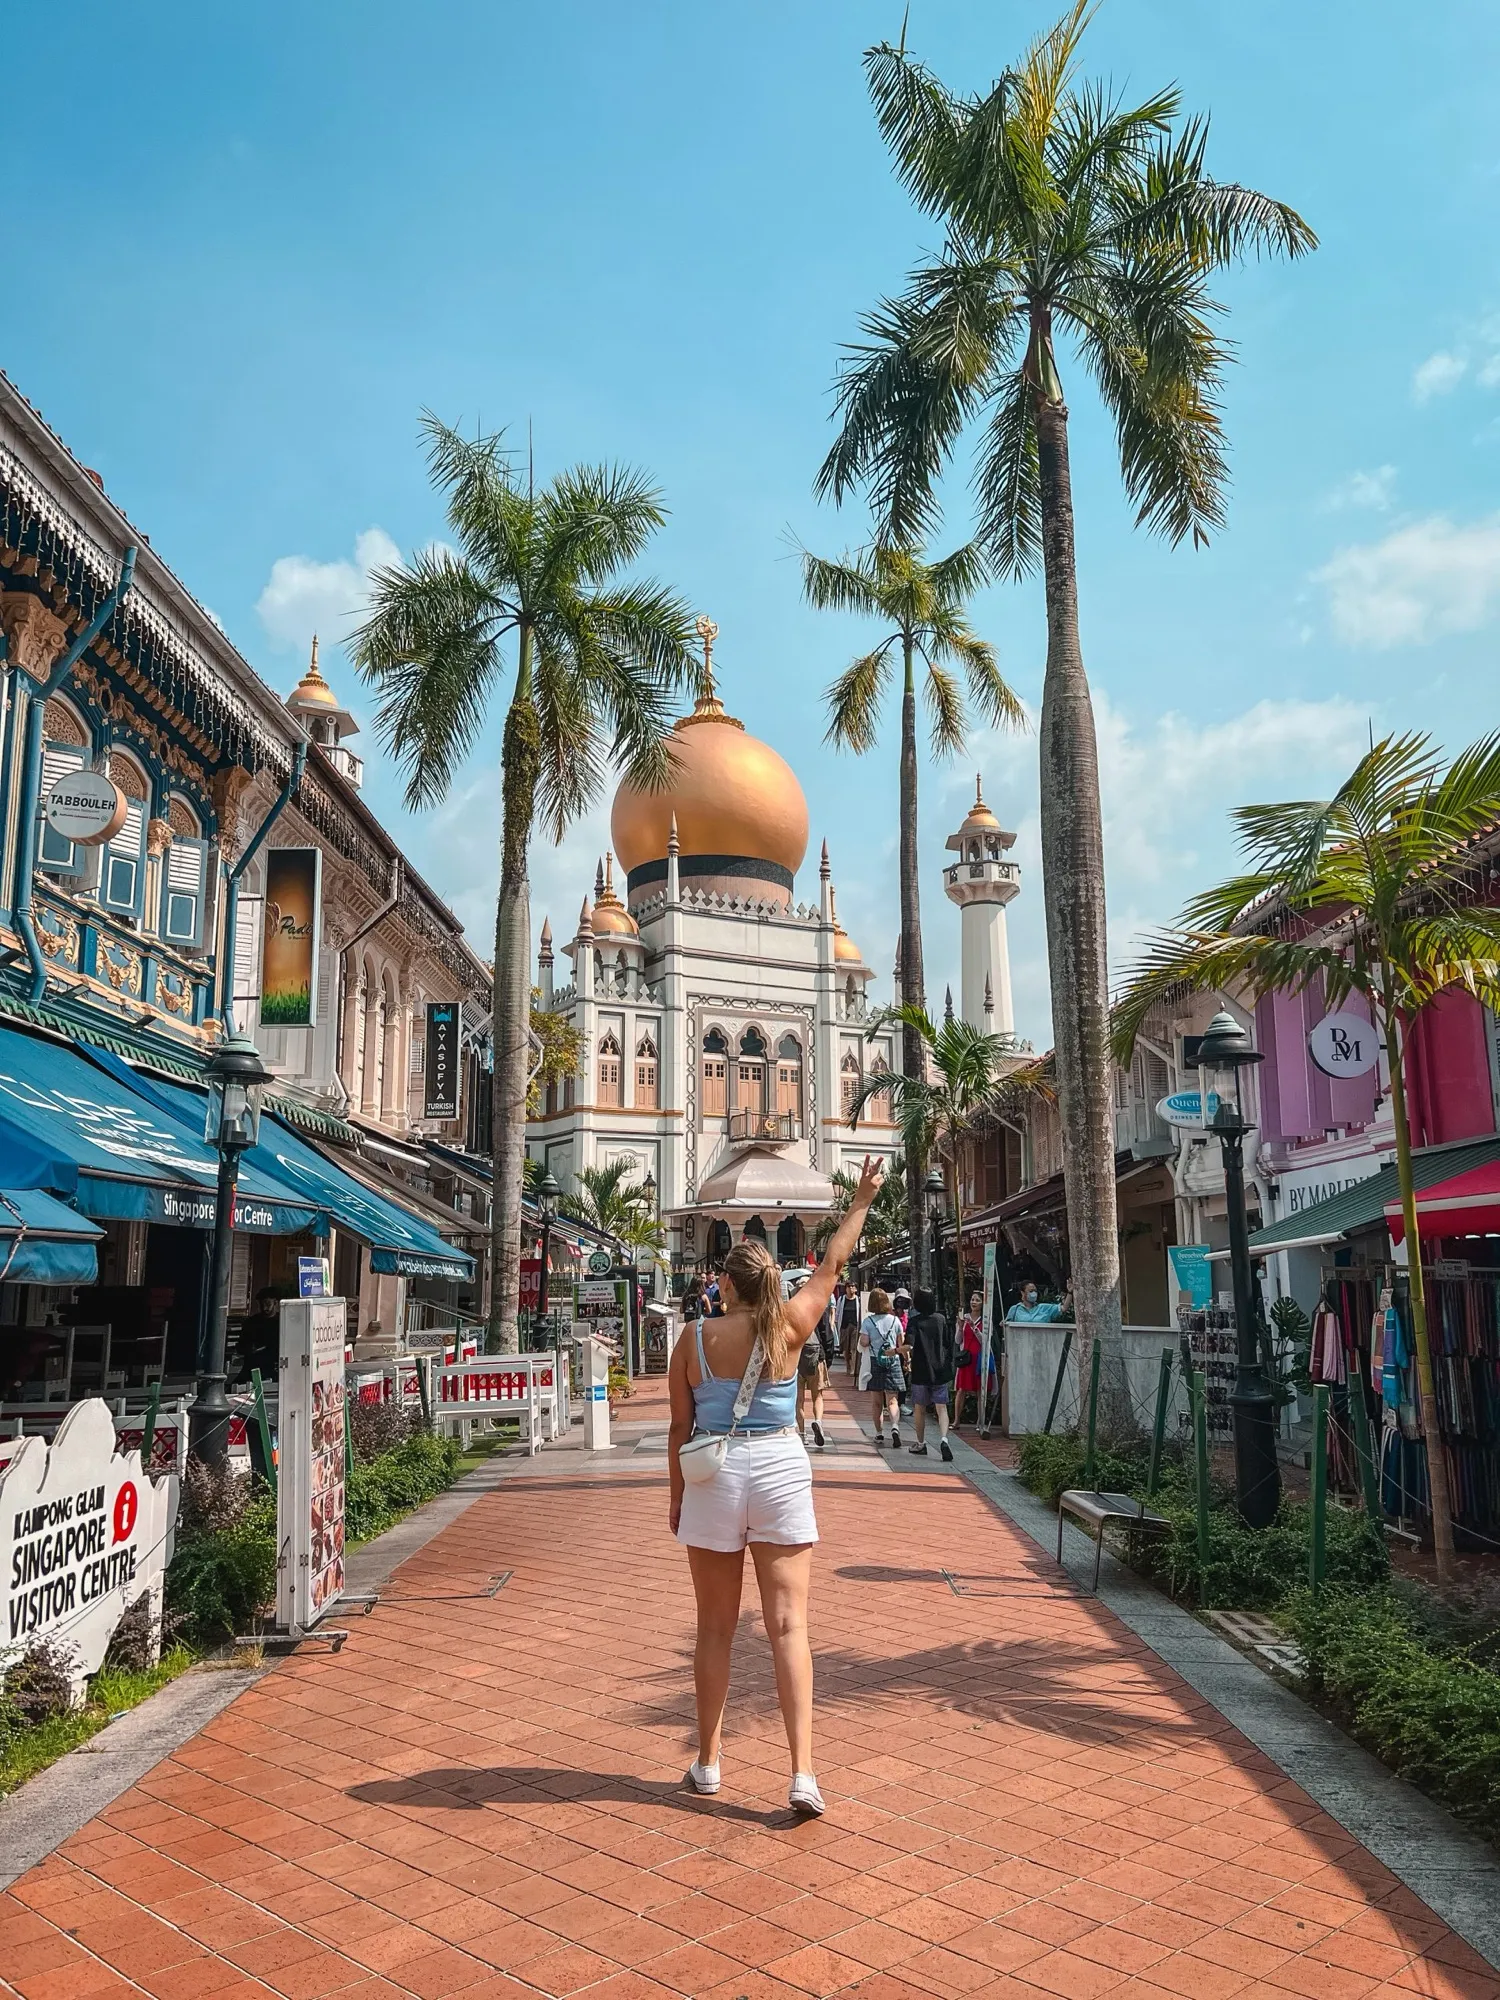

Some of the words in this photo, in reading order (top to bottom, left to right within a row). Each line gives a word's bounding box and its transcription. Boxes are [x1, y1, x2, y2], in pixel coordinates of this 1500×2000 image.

[50, 794, 116, 811] TABBOULEH
[436, 1024, 447, 1100] AYASOFYA
[164, 1193, 215, 1222] Singapore
[244, 1205, 273, 1226] Centre
[1289, 1187, 1305, 1211] BY
[520, 1272, 539, 1292] 50
[13, 1496, 73, 1541] KAMPONG
[76, 1485, 105, 1516] GLAM
[10, 1514, 107, 1590] SINGAPORE
[9, 1571, 76, 1640] VISITOR
[81, 1544, 138, 1604] CENTRE
